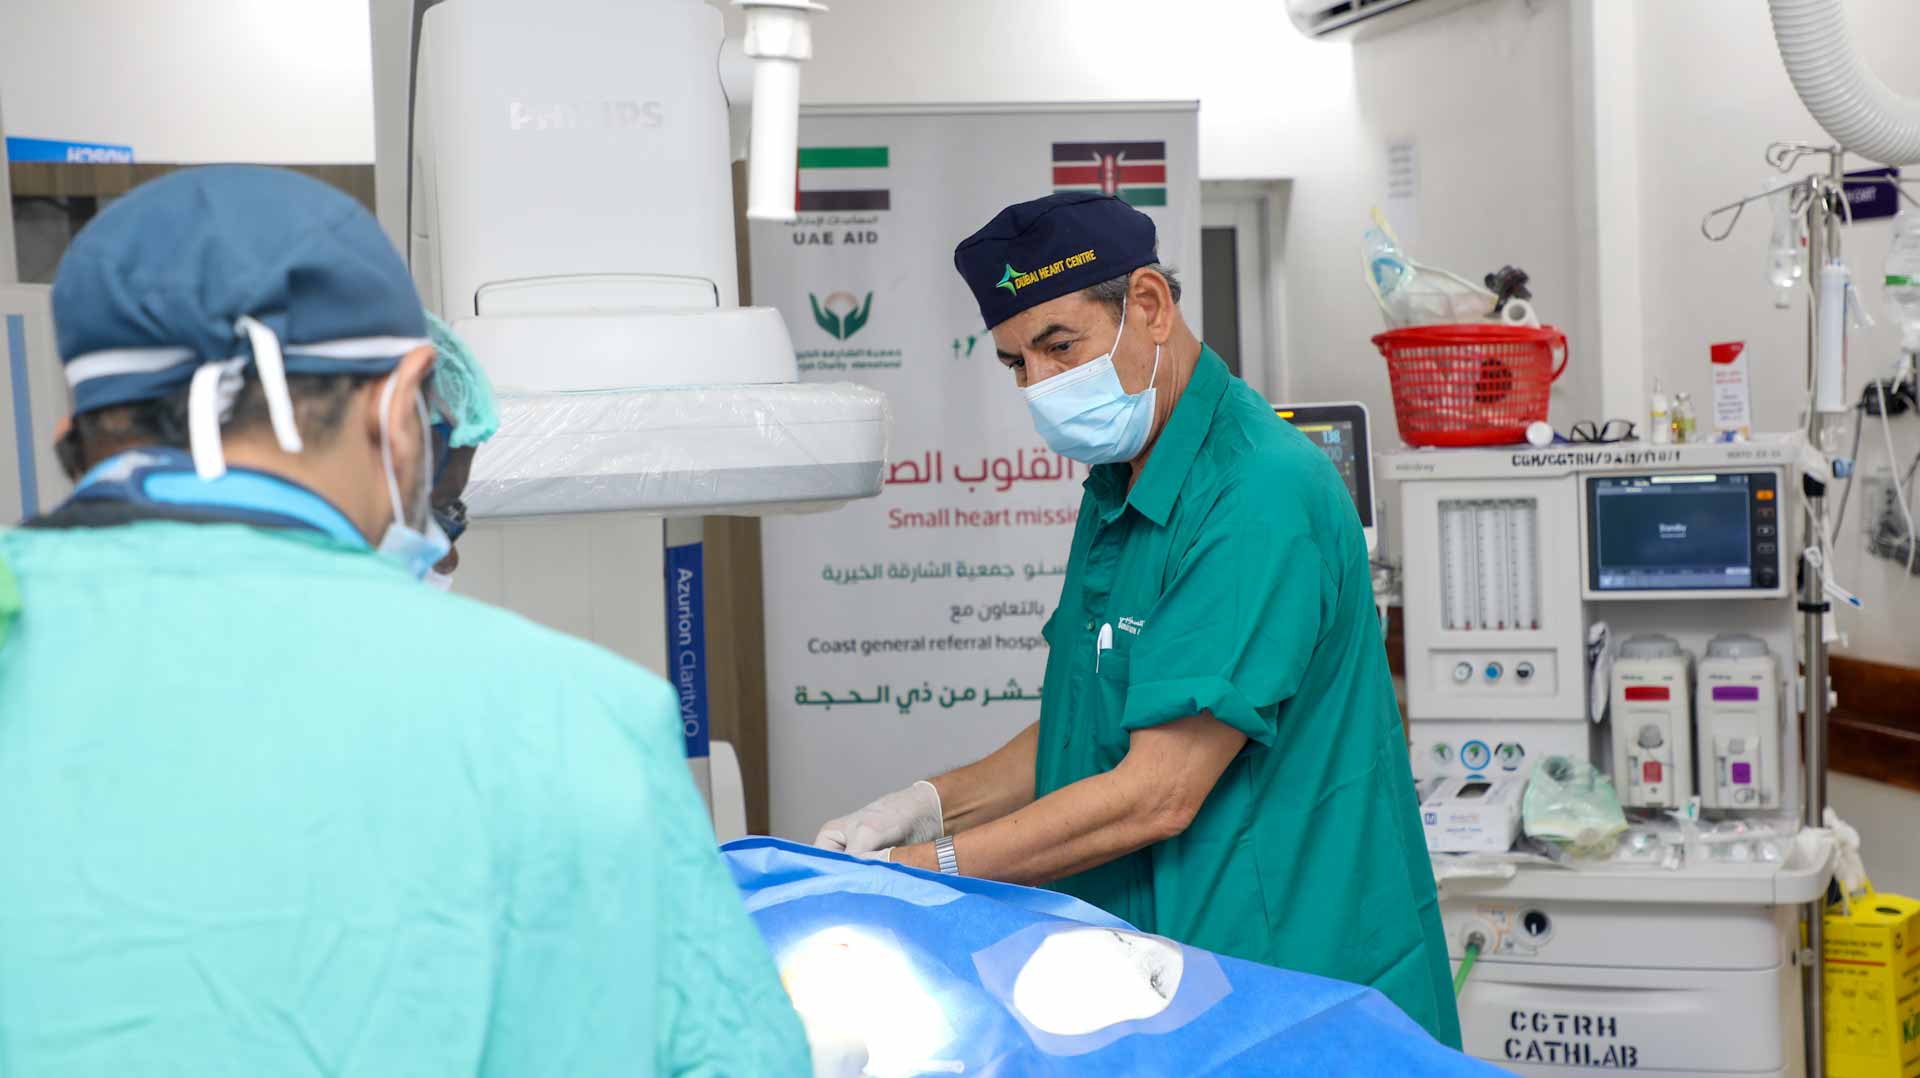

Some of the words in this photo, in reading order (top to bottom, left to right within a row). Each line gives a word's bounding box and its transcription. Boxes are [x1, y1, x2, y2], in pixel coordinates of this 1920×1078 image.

[793, 231, 834, 246] UAE
[843, 231, 879, 245] AID
[1014, 270, 1040, 290] DUBAI
[1038, 260, 1066, 281] HEART
[1065, 248, 1097, 270] CENTRE
[953, 446, 1075, 493] القلوب
[888, 508, 949, 529] Small
[954, 507, 1011, 527] heart
[822, 562, 883, 585] الخيرية
[887, 560, 951, 583] الشارقة
[955, 559, 1015, 578] جمعية
[676, 567, 694, 647] Azurion
[949, 603, 975, 624] مع
[978, 600, 1045, 623] بالتعاون
[807, 636, 857, 655] Coast
[861, 635, 926, 656] general
[929, 634, 993, 651] referral
[794, 684, 890, 710] الحجة
[895, 681, 933, 714] ذي
[938, 686, 977, 709] من
[1510, 1010, 1617, 1038] CGTRH
[1504, 1038, 1638, 1068] CATHLAB
